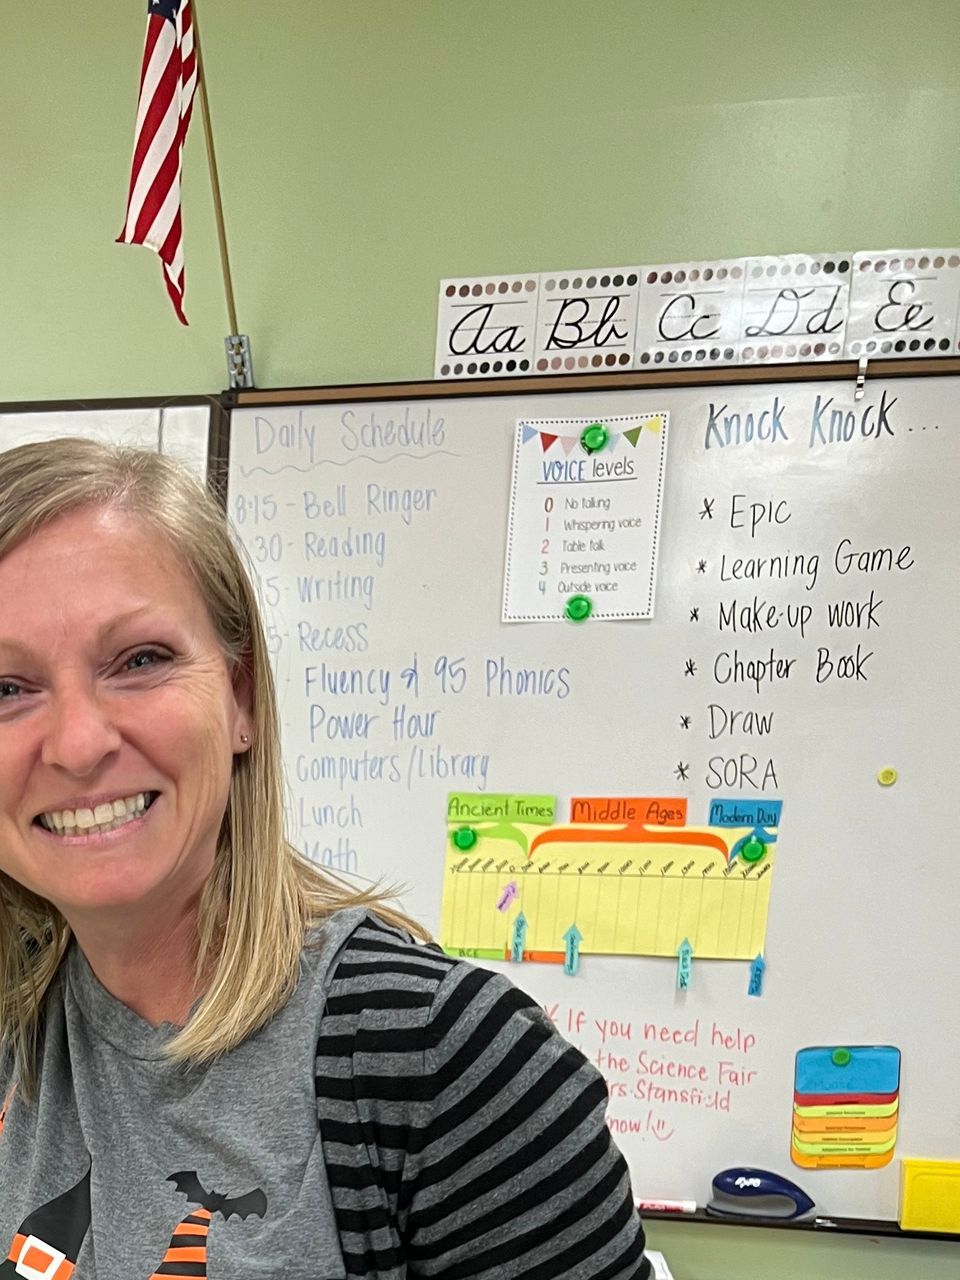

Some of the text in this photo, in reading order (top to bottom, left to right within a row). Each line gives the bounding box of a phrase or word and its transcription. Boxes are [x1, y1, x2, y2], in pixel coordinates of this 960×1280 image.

[449, 280, 933, 355] Aa Bb Cc Dd Ee
[254, 408, 447, 464] Daily Schedule
[704, 397, 789, 450] Knock
[542, 456, 634, 481] VOICE levels
[304, 484, 346, 519] Bell
[367, 483, 438, 526] Ringer
[544, 497, 611, 513] 0 No talking
[730, 494, 792, 538] Epic
[545, 517, 642, 533] 1 Whispering voice
[304, 533, 386, 567] Reading
[541, 539, 605, 554] 2 Table talk
[719, 538, 915, 591] Learning Game
[539, 560, 638, 576] 3 Presenting voice
[297, 574, 374, 611] Writing
[538, 580, 618, 595] 4 Outside voice
[718, 590, 884, 638] Make-up work
[298, 620, 369, 652] Recess
[305, 663, 390, 706] Fluency
[434, 656, 466, 694] 95
[485, 657, 571, 699] Phonics
[713, 644, 874, 694] Chapter Book
[309, 704, 441, 743] Power Hour
[707, 704, 775, 740] Draw
[706, 753, 779, 791] SORA
[299, 796, 364, 830] Lunch
[448, 797, 554, 818] Ancient Times
[572, 801, 683, 825] Middle Ages
[568, 1008, 756, 1053] If you need help
[595, 1049, 758, 1086] the Science Fair
